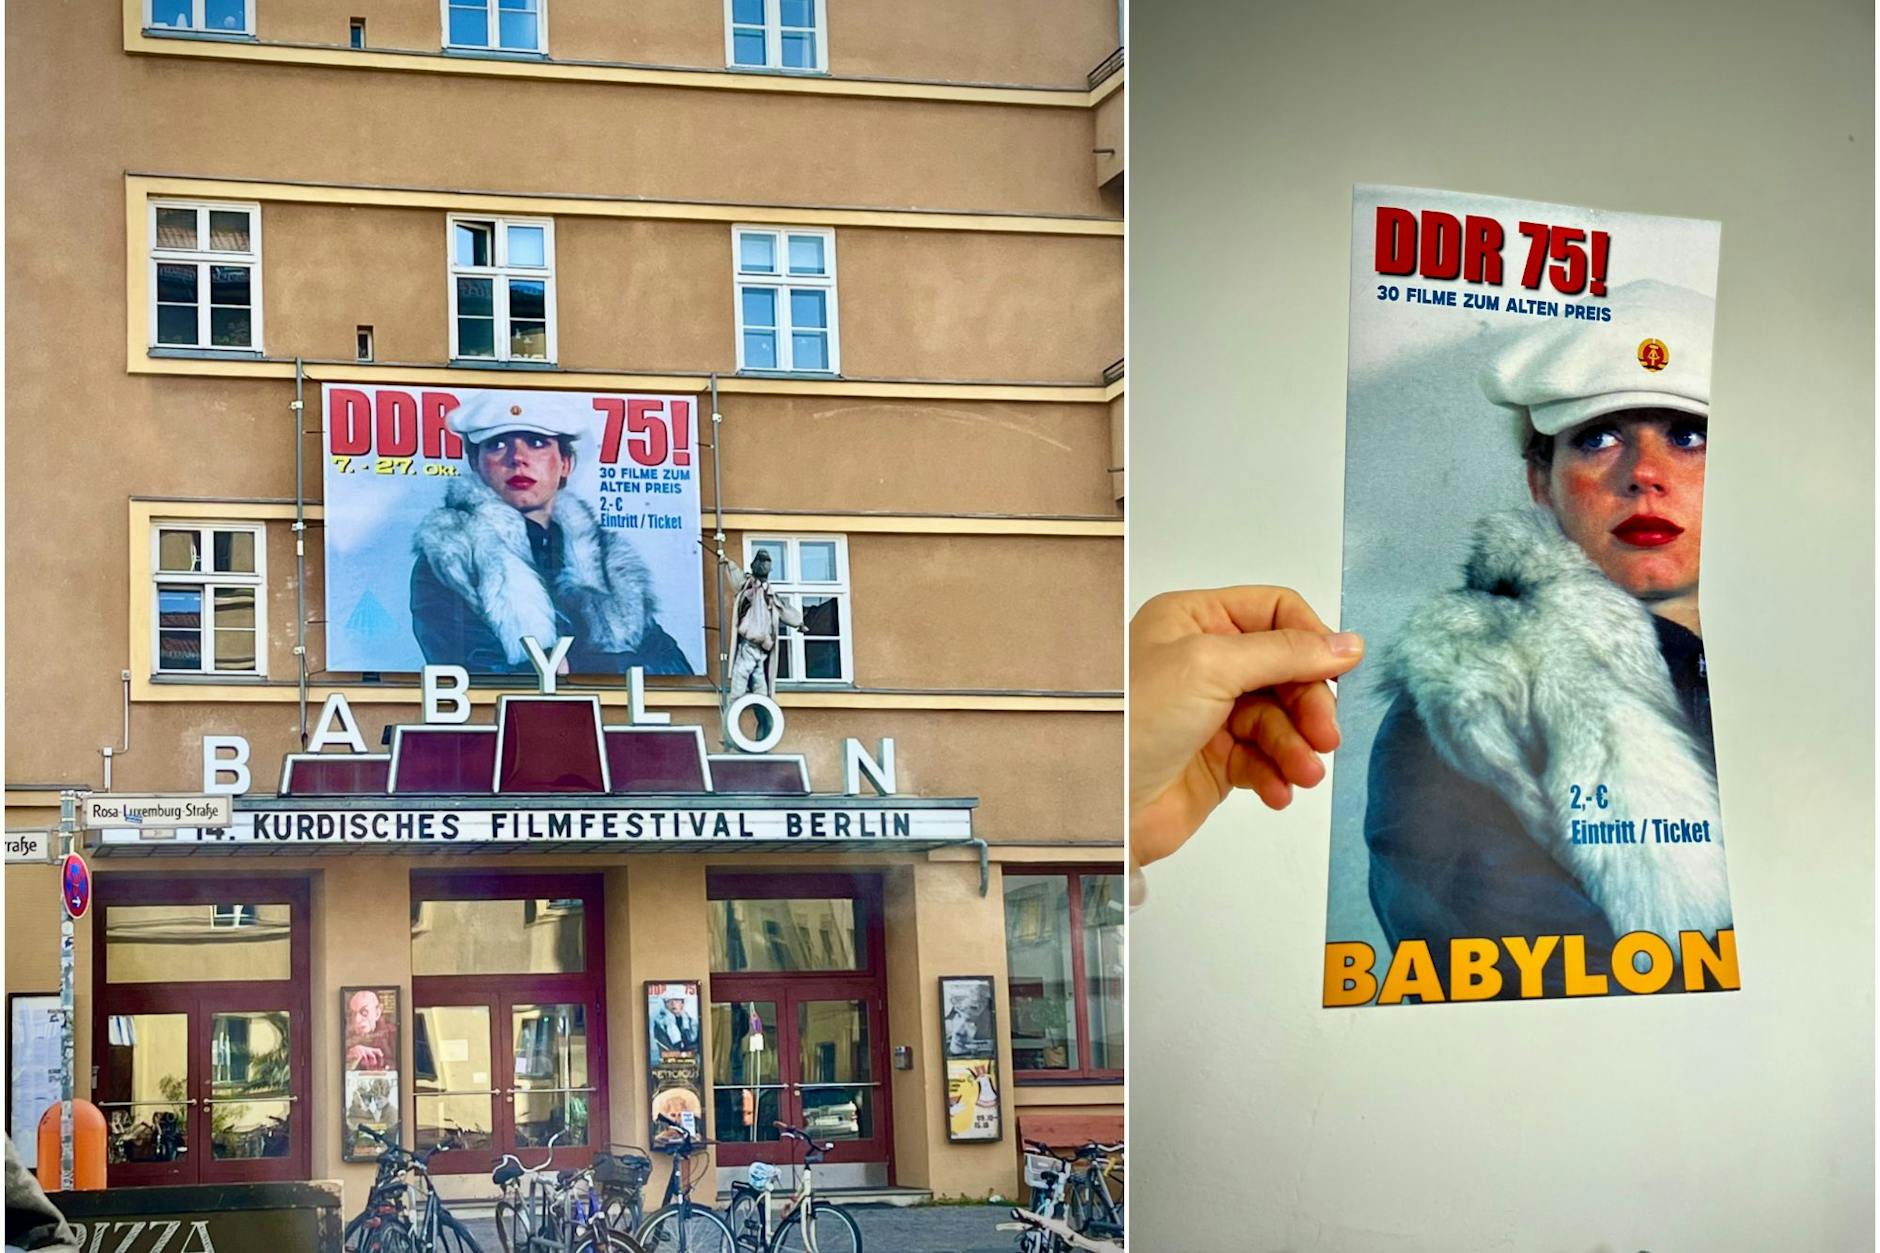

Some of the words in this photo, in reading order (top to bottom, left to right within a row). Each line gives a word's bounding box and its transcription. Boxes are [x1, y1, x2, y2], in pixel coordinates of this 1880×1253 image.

[1375, 206, 1505, 287] DDR
[1519, 221, 1611, 297] 75!
[1377, 285, 1400, 301] 30
[1406, 288, 1458, 307] FILME
[1463, 293, 1500, 312] ZUM
[1506, 298, 1559, 318] ALTEN
[1565, 304, 1612, 322] PREIS
[329, 388, 463, 460] DDR
[592, 397, 691, 467] 75!
[331, 456, 354, 474] 7.
[375, 457, 418, 476] 27.
[423, 463, 461, 477] Okt.
[599, 467, 616, 479] 30
[621, 468, 658, 480] FILME
[663, 469, 691, 481] ZUM
[600, 481, 640, 493] ALTEN
[645, 483, 682, 495] PREIS
[600, 513, 638, 528] Eintritt
[647, 514, 683, 529] Ticket
[202, 635, 898, 797] BABYLON
[1596, 783, 1609, 809] €
[254, 813, 460, 840] KURDISCHES
[491, 812, 754, 839] FILMFESTIVAL
[786, 811, 911, 838] BERLIN
[1572, 819, 1637, 845] Eintritt
[1652, 818, 1712, 844] Ticket
[5, 835, 38, 856] raße
[1323, 930, 1741, 1009] BABYLON
